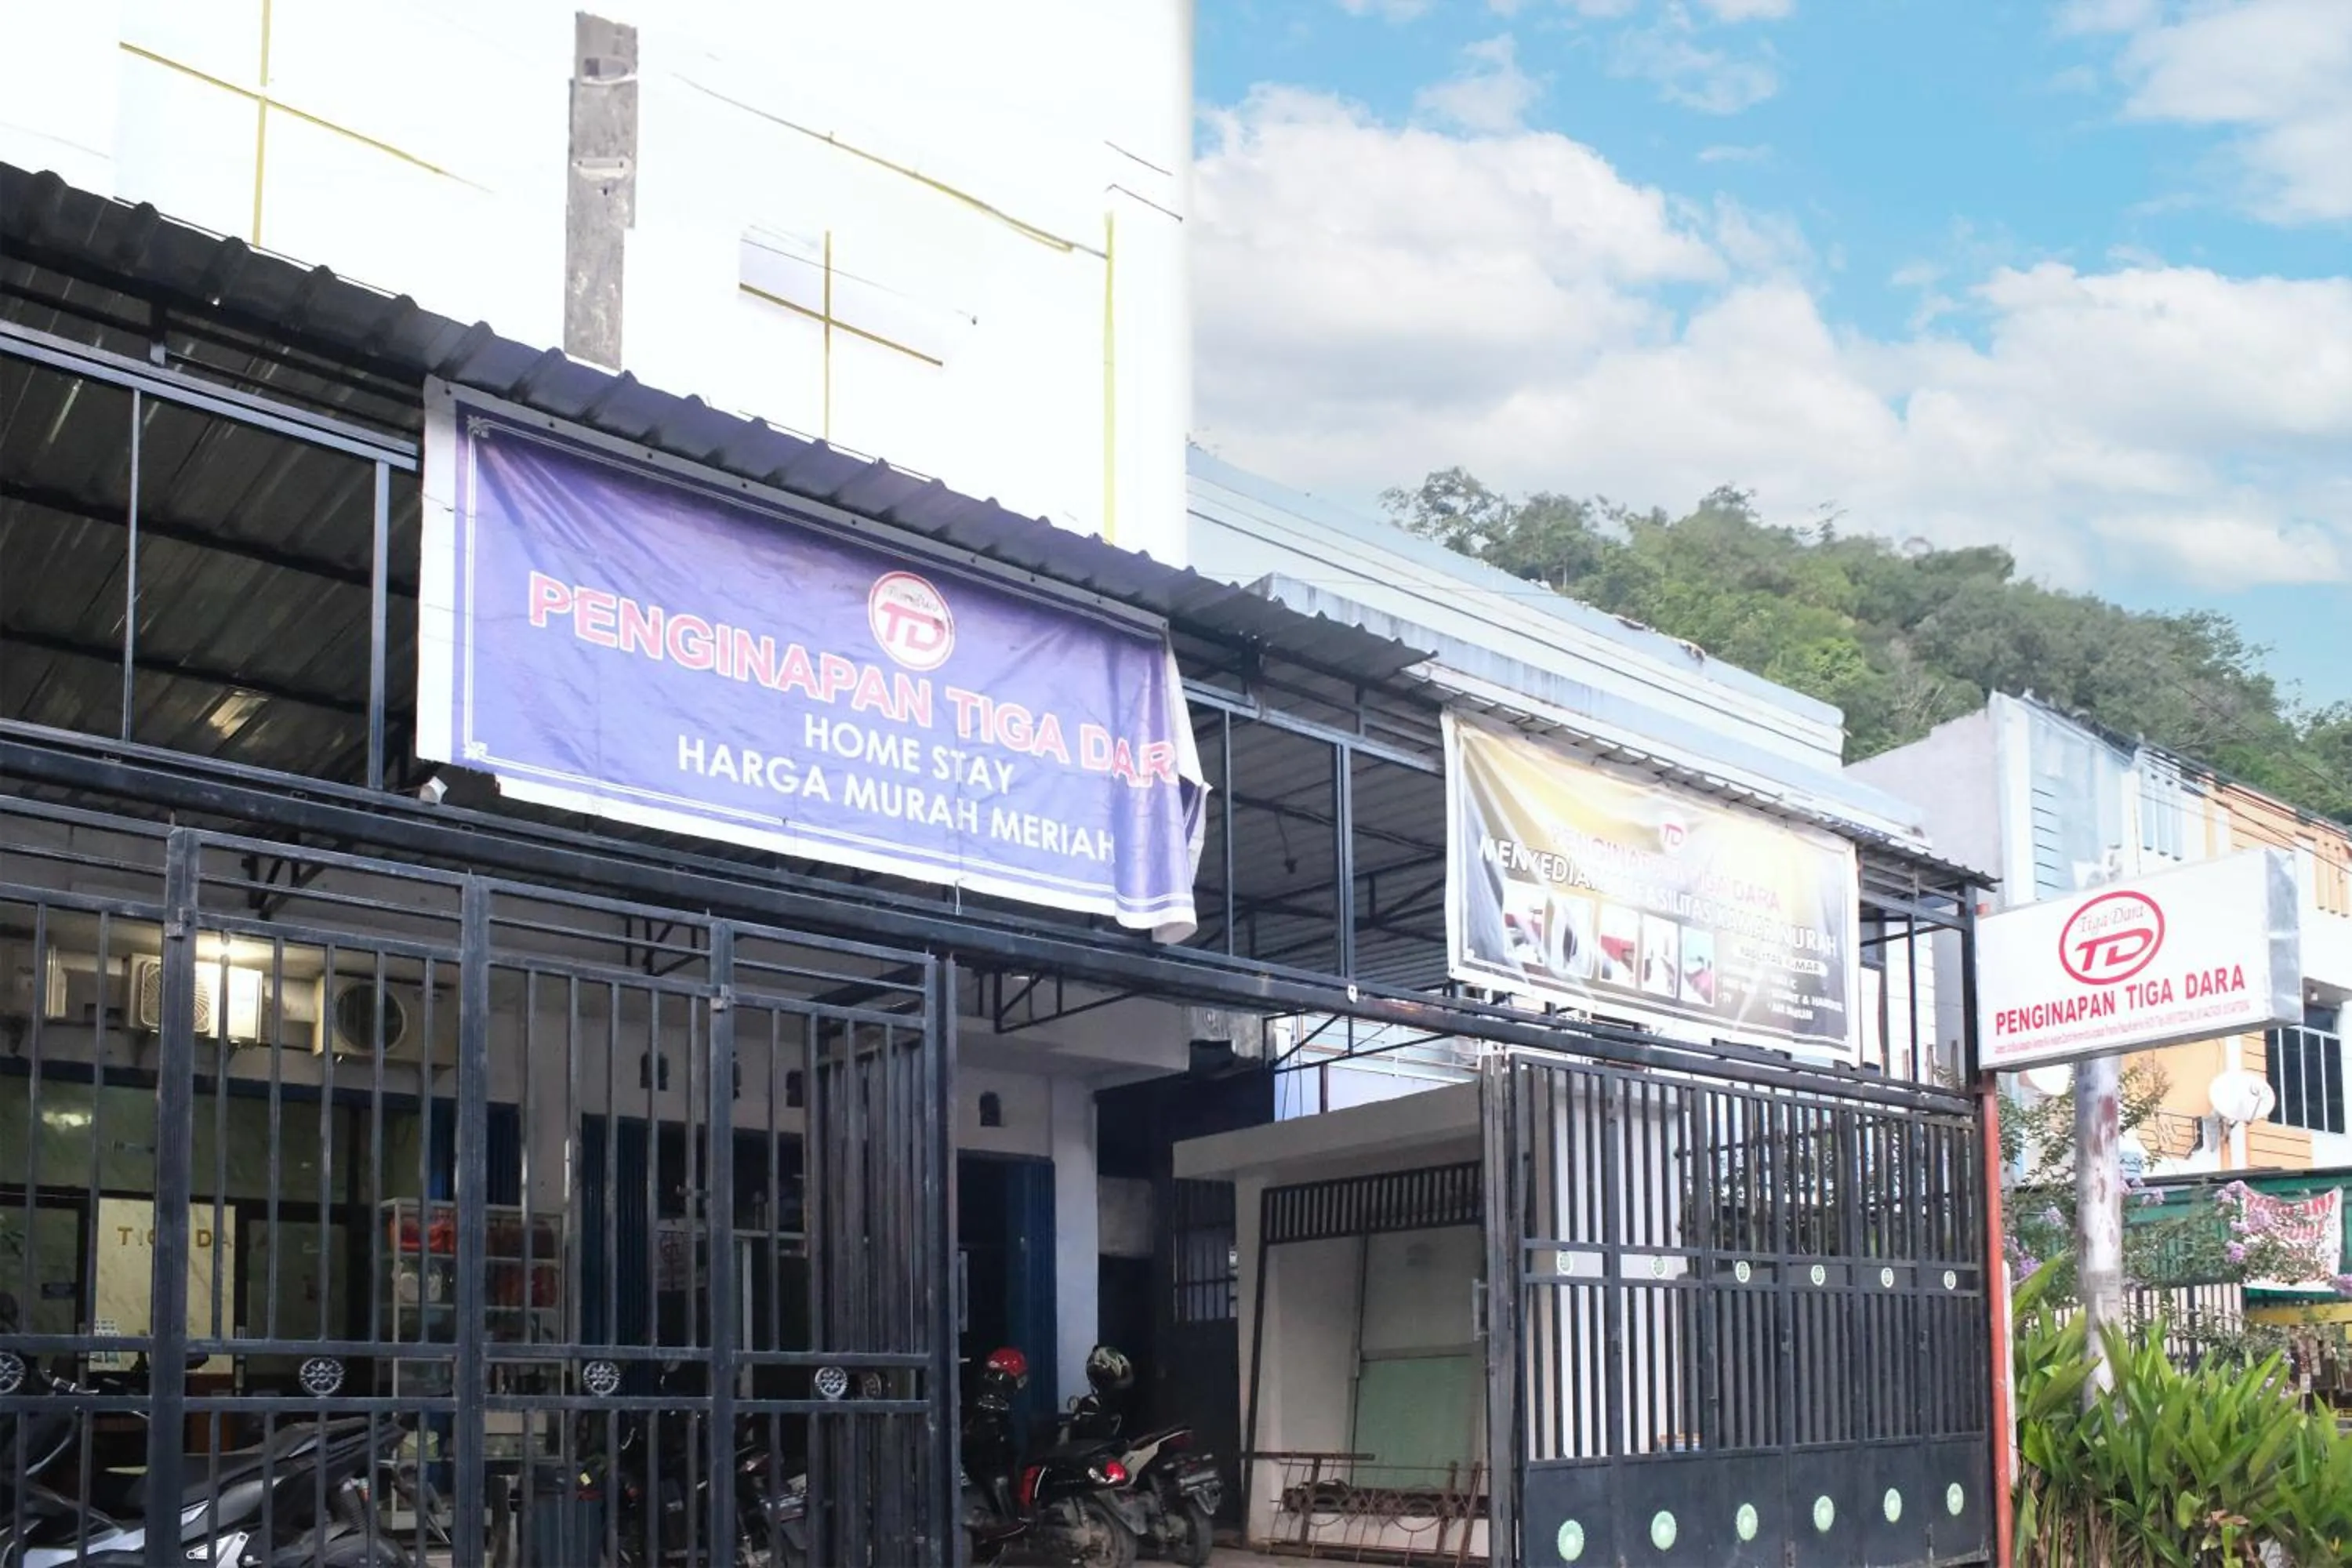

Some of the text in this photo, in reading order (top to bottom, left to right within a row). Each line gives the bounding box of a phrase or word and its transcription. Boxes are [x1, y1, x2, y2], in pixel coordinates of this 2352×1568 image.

[529, 570, 1179, 788] PENGINAPAN TIGA DAR
[805, 713, 1014, 795] HOME STAY
[678, 735, 1115, 862] HARGA MURAH MERIAH
[1633, 881, 1712, 924] FASILITAS
[1730, 877, 1780, 913] DARA
[1786, 956, 1820, 973] MAR
[2074, 927, 2154, 972] TD
[1995, 991, 2116, 1036] PENGINAPAN
[2125, 978, 2173, 1011] TIGA
[2185, 964, 2245, 1000] DARA
